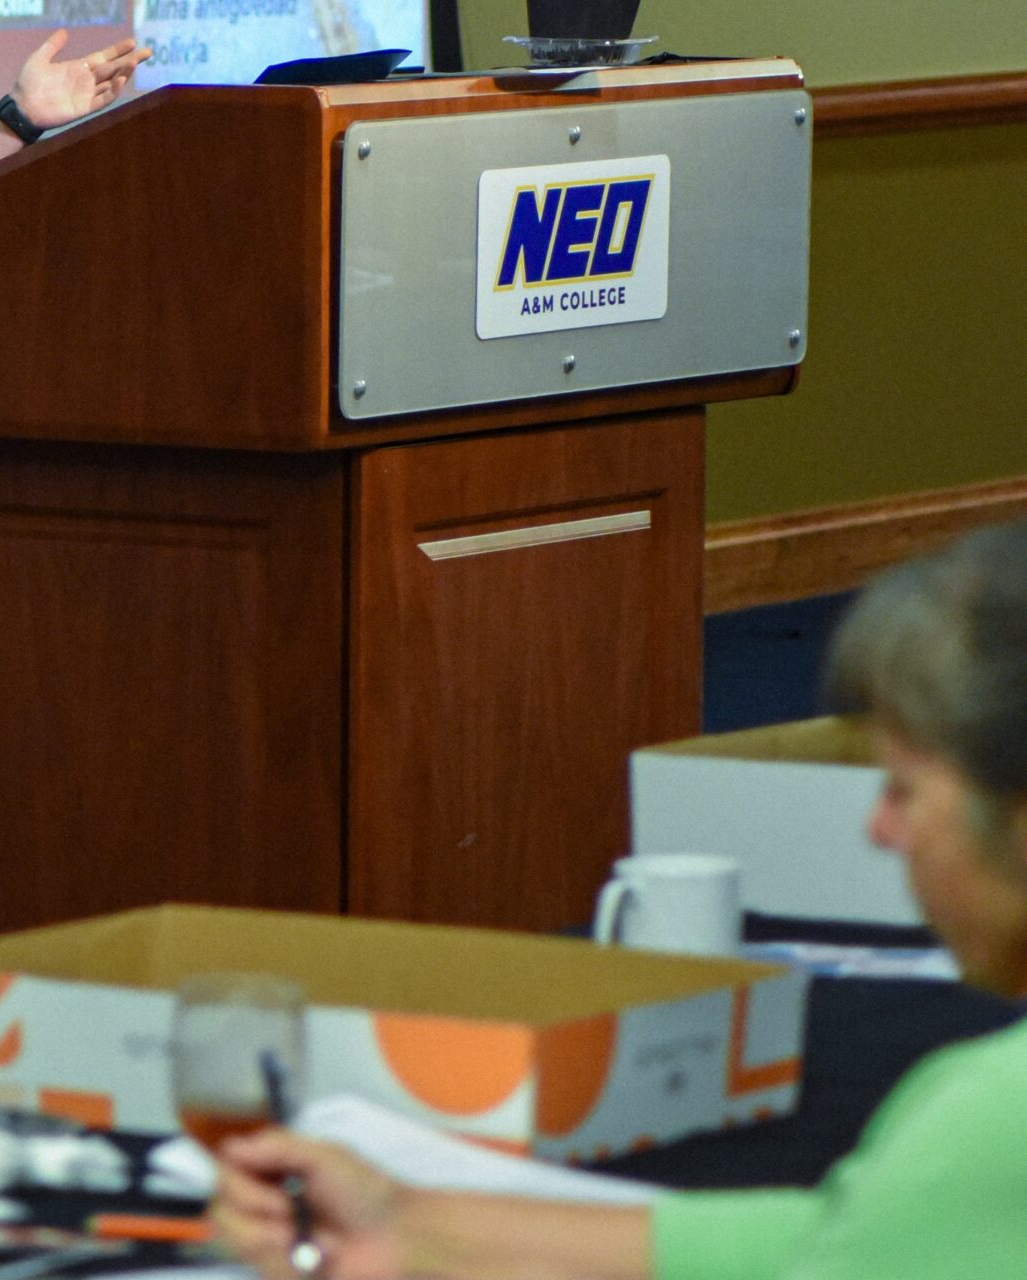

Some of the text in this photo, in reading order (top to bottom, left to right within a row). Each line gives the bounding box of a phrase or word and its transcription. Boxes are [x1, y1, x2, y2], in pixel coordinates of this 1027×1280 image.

[493, 173, 655, 293] NEO
[520, 286, 626, 316] A&M COLLEGE
